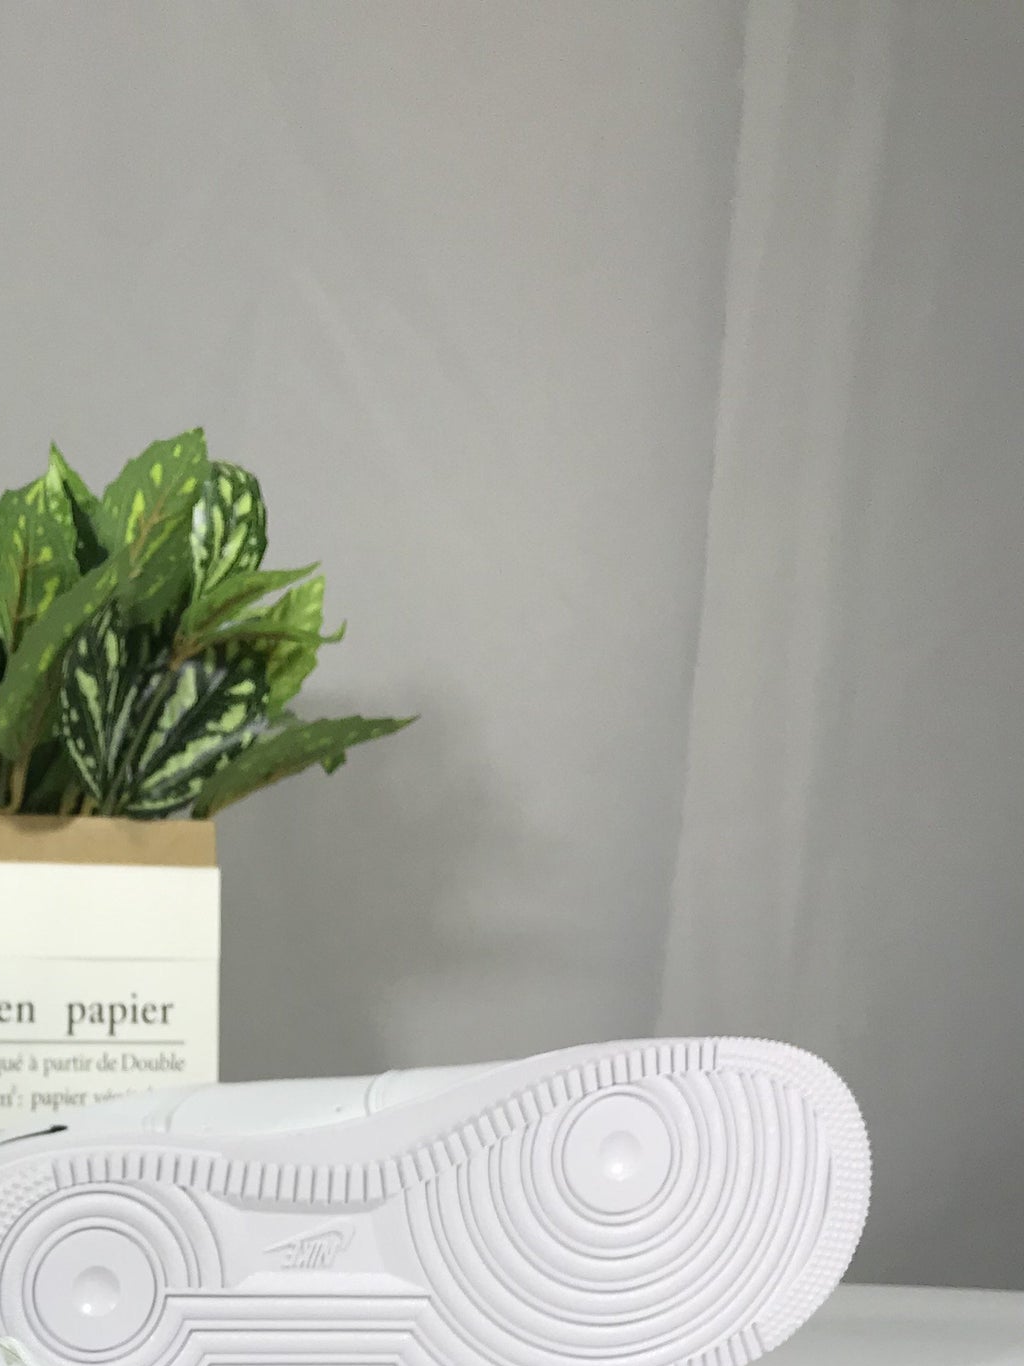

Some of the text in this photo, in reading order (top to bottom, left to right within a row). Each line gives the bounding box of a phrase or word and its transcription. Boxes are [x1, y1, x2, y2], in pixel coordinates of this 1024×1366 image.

[67, 992, 174, 1036] papier
[28, 1051, 39, 1072] à
[43, 1053, 94, 1077] partir
[96, 1052, 118, 1072] de
[121, 1052, 186, 1073] Double
[31, 1089, 87, 1112] papier
